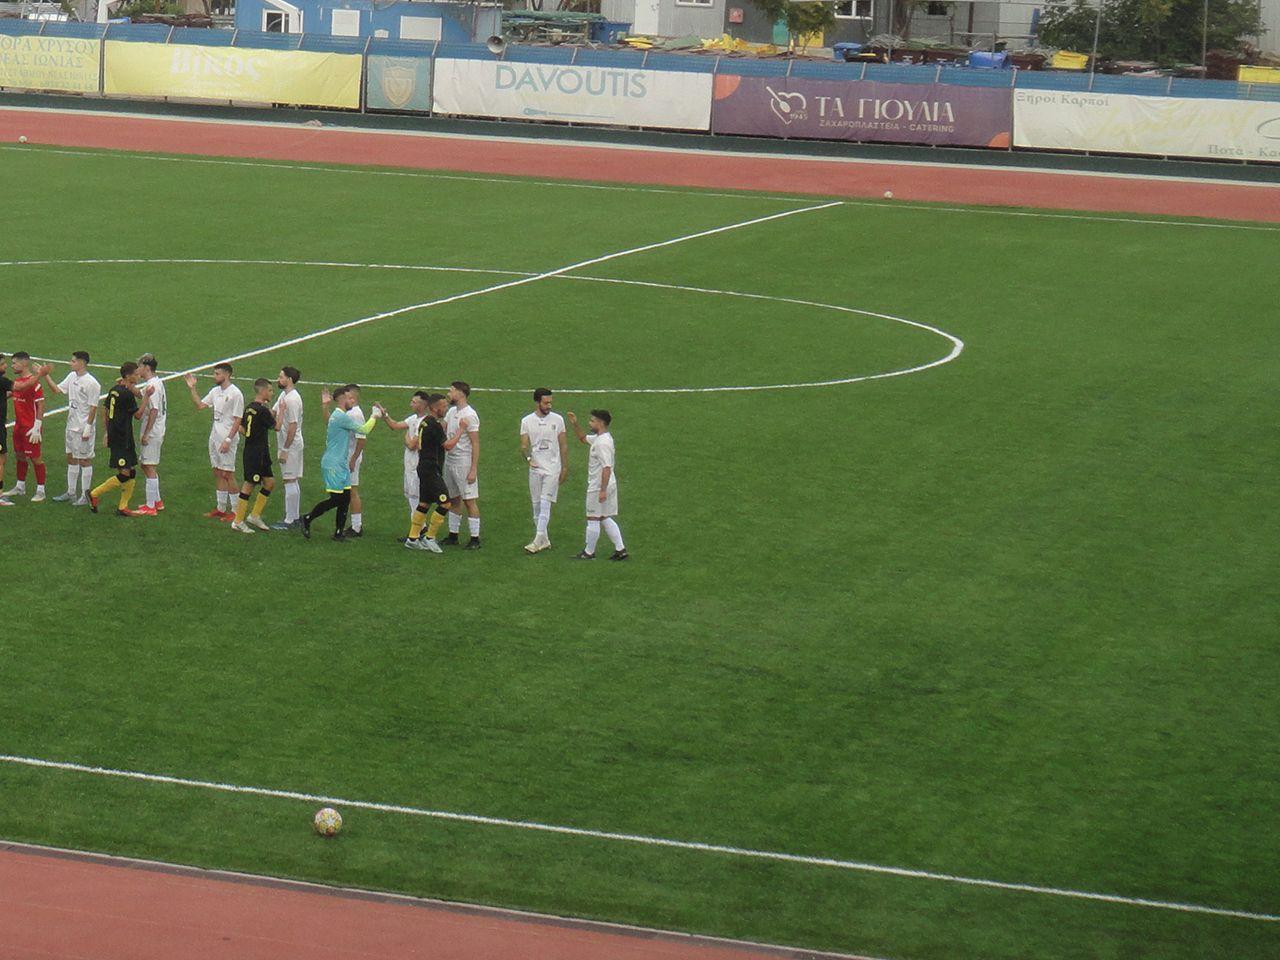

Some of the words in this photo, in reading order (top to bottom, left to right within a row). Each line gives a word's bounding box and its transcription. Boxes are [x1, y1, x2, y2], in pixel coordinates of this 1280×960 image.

[33, 54, 83, 68] ΙΩΝΙΑΣ
[495, 64, 647, 98] DAVOUTIS
[815, 96, 845, 118] ΤΑ
[859, 98, 955, 122] ΓΙΟΥΛΙΑ
[909, 123, 955, 133] CATERING
